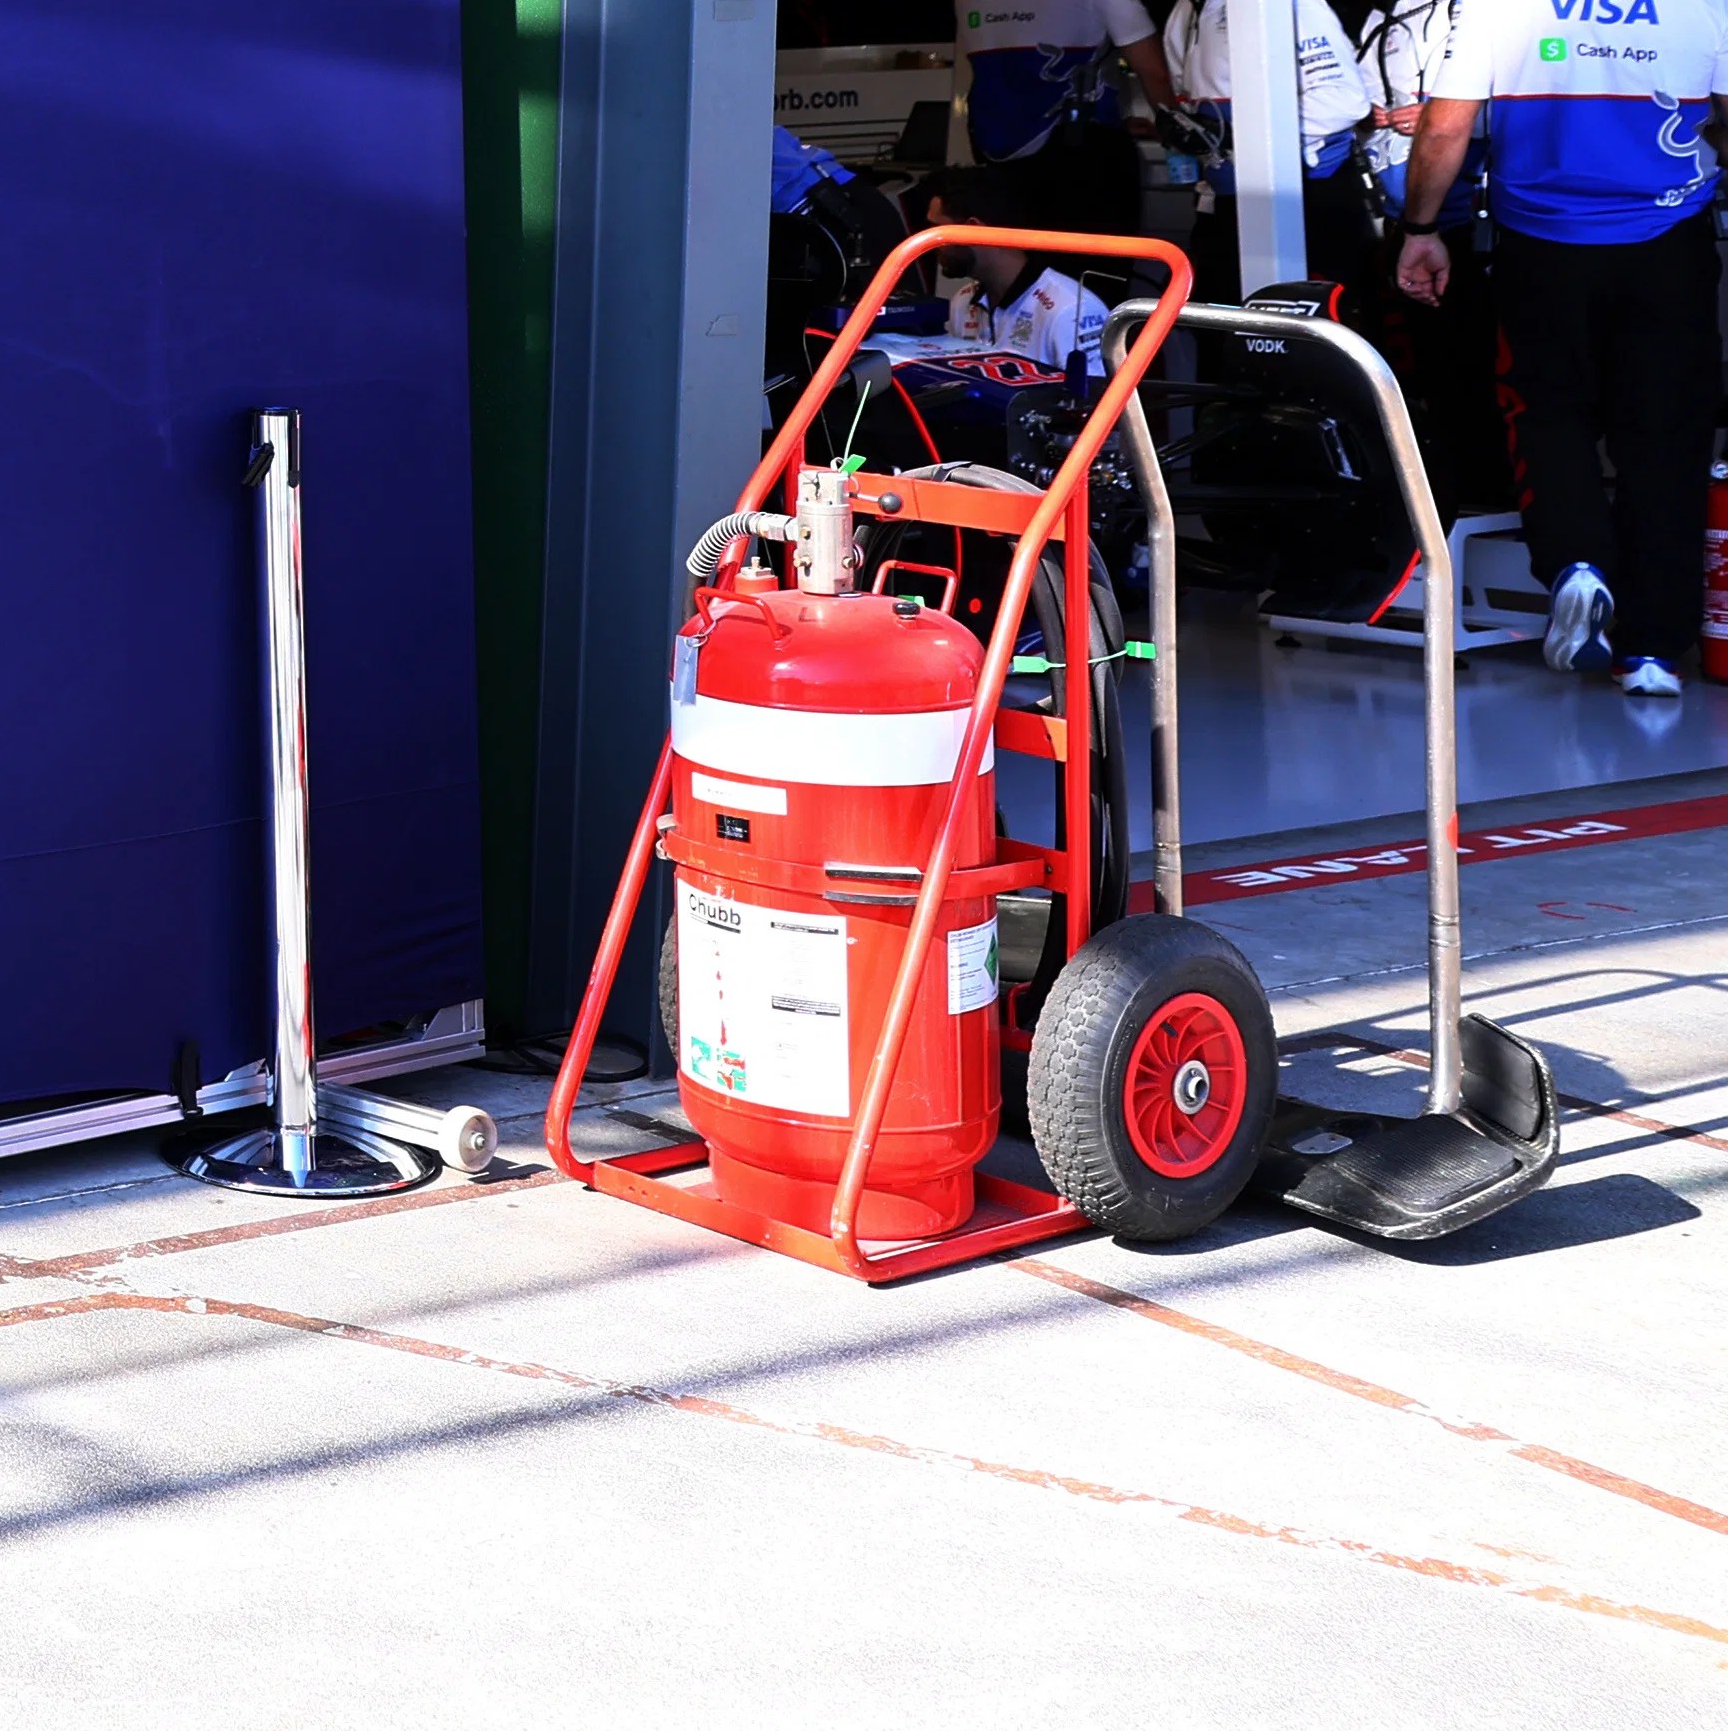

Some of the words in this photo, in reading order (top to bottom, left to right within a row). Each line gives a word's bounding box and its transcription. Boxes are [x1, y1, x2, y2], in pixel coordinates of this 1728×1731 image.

[1576, 42, 1618, 59] Cash
[1622, 46, 1658, 63] App
[1485, 821, 1628, 849] PIT
[688, 893, 742, 927] Chubb
